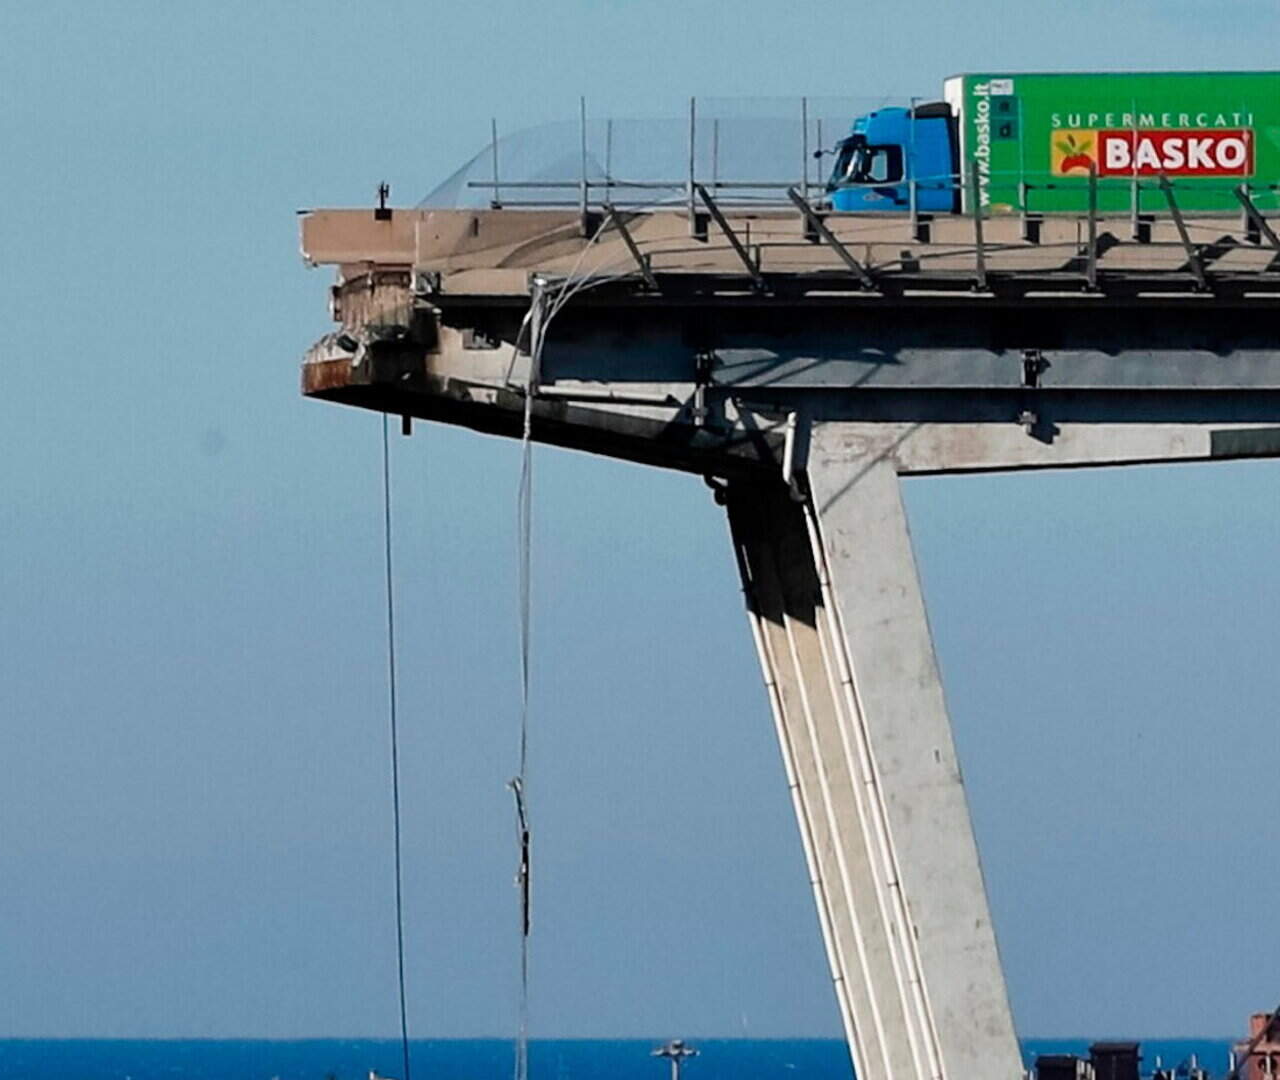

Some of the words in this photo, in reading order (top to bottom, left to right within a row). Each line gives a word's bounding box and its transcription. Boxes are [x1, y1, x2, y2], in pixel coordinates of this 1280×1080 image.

[1051, 113, 1254, 128] SUPERMERCATI
[973, 83, 990, 207] www.basko.it
[1105, 138, 1247, 169] BASKO
